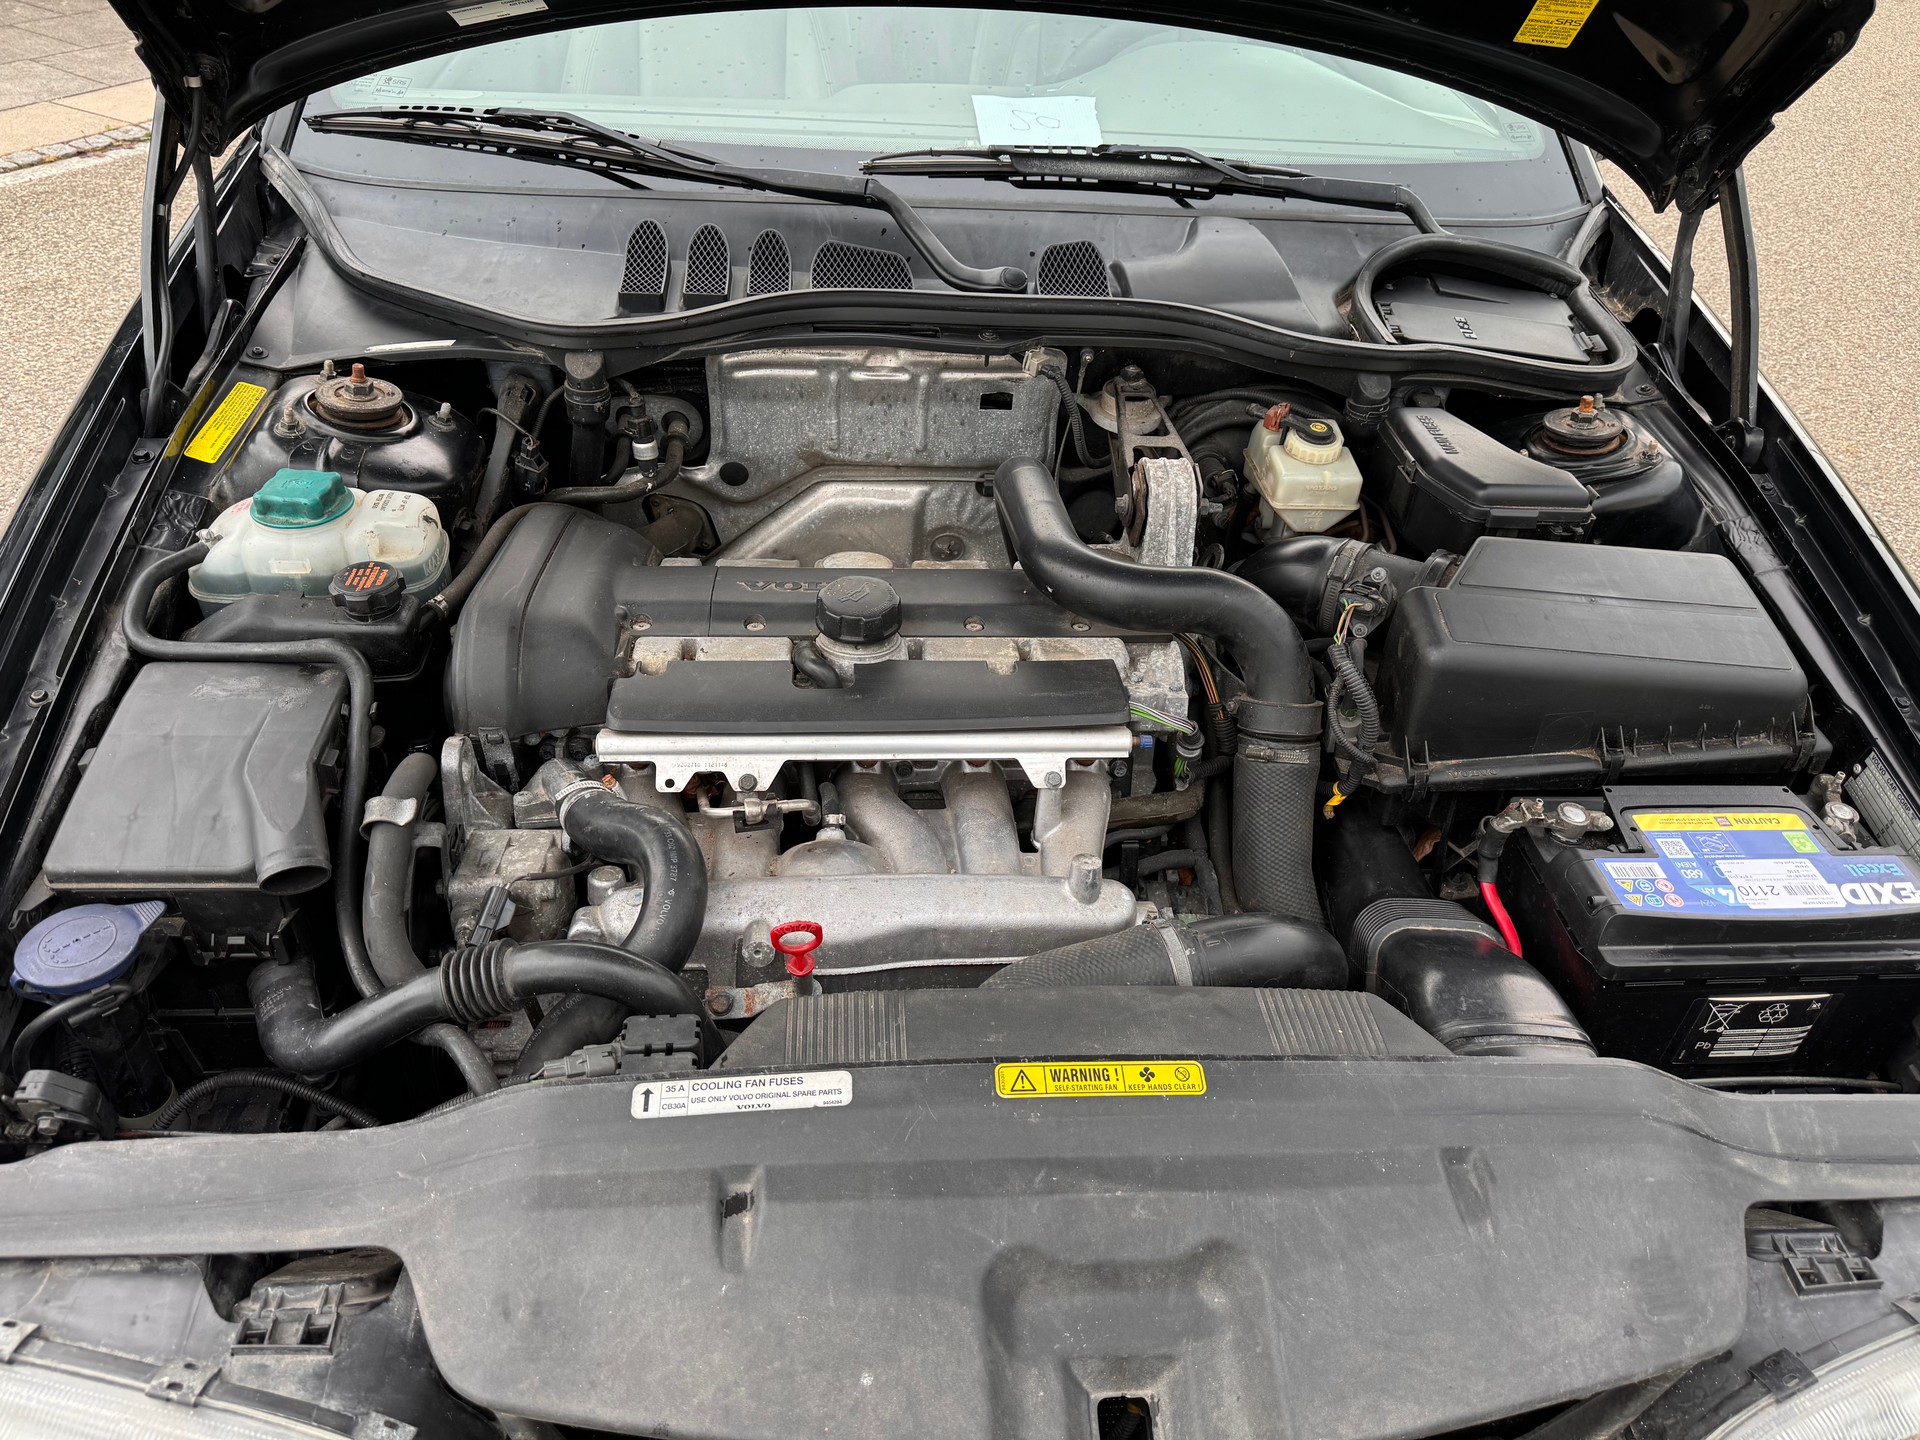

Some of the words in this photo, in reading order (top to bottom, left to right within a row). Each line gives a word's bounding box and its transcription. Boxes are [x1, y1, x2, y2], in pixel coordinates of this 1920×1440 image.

[1554, 18, 1583, 27] SRS
[1454, 316, 1477, 339] FUSE
[1416, 415, 1444, 436] FUSES
[1433, 436, 1459, 454] MAIN
[737, 581, 829, 592] VOL
[1871, 754, 1887, 776] VOLVO
[1886, 777, 1898, 793] CAR
[1734, 817, 1780, 825] CAUTION
[1681, 869, 1704, 879] 680
[1844, 863, 1904, 877] Excell
[1737, 885, 1780, 896] 2110
[1830, 882, 1920, 905] EXID
[656, 900, 672, 925] VOLVO
[1694, 1041, 1712, 1050] Pb
[1050, 1068, 1110, 1083] WARNING
[1114, 1068, 1120, 1082] !
[666, 1085, 677, 1093] 35
[678, 1084, 685, 1092] A
[691, 1079, 742, 1092] COOLING
[745, 1078, 767, 1088] FAN
[769, 1076, 804, 1087] FUSES
[1055, 1084, 1104, 1092] SELF-STARTING
[1128, 1083, 1146, 1091] KEEP
[1147, 1083, 1173, 1091] HANDS
[1174, 1083, 1196, 1091] CLEAR
[690, 1096, 706, 1104] USE
[707, 1095, 728, 1103] ONLY
[729, 1093, 754, 1101] VOLVO
[755, 1091, 791, 1100] ORIGINAL
[792, 1089, 817, 1097] SPARE
[818, 1088, 843, 1096] PARTS
[661, 1102, 686, 1111] CB30A
[736, 1103, 771, 1111] VOLVO
